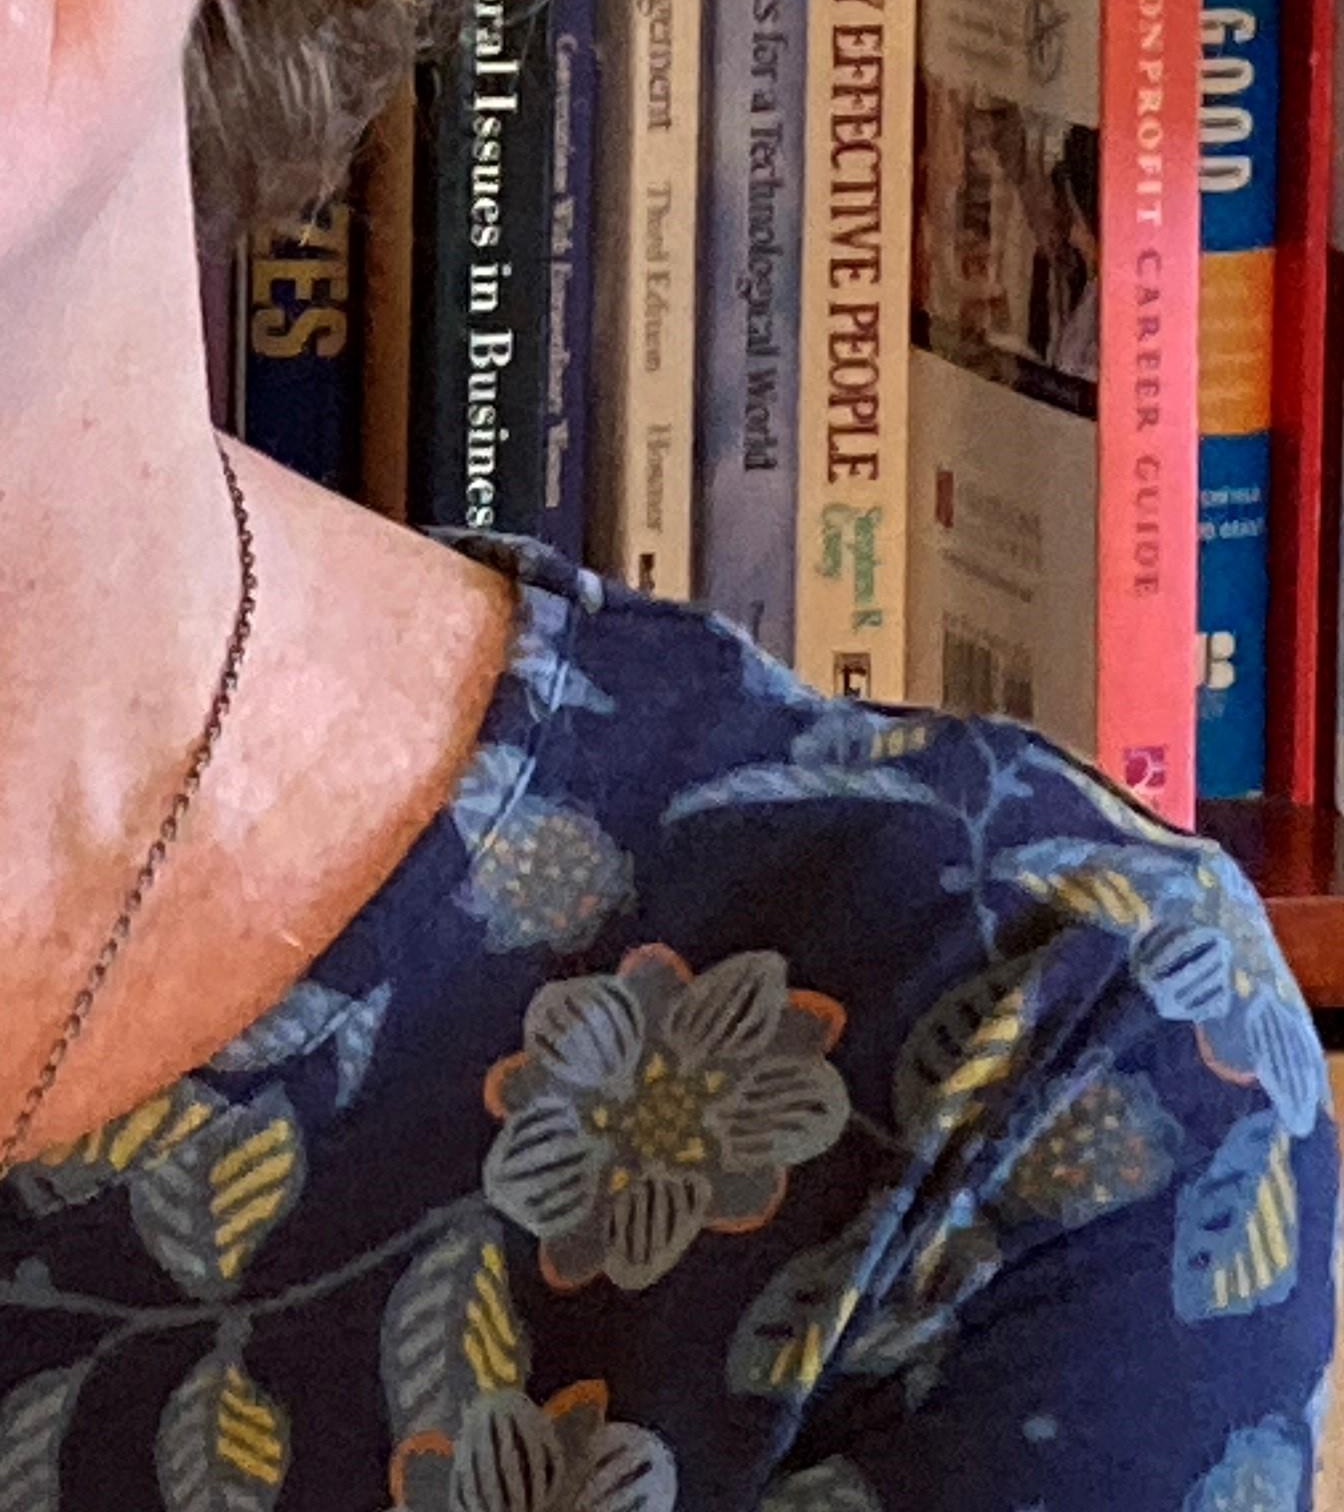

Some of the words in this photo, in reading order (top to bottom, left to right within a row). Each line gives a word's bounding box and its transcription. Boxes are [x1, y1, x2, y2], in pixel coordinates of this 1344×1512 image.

[751, 34, 788, 77] for
[751, 93, 774, 114] a
[469, 90, 519, 249] Issues
[830, 24, 884, 288] EFFECTIVE
[469, 264, 512, 314] in
[736, 124, 784, 356] Technological
[743, 367, 779, 472] World
[827, 303, 880, 483] PEOPLE
[1133, 249, 1162, 433] CAREER
[465, 329, 513, 528] Busines
[1132, 456, 1162, 597] GUIDE
